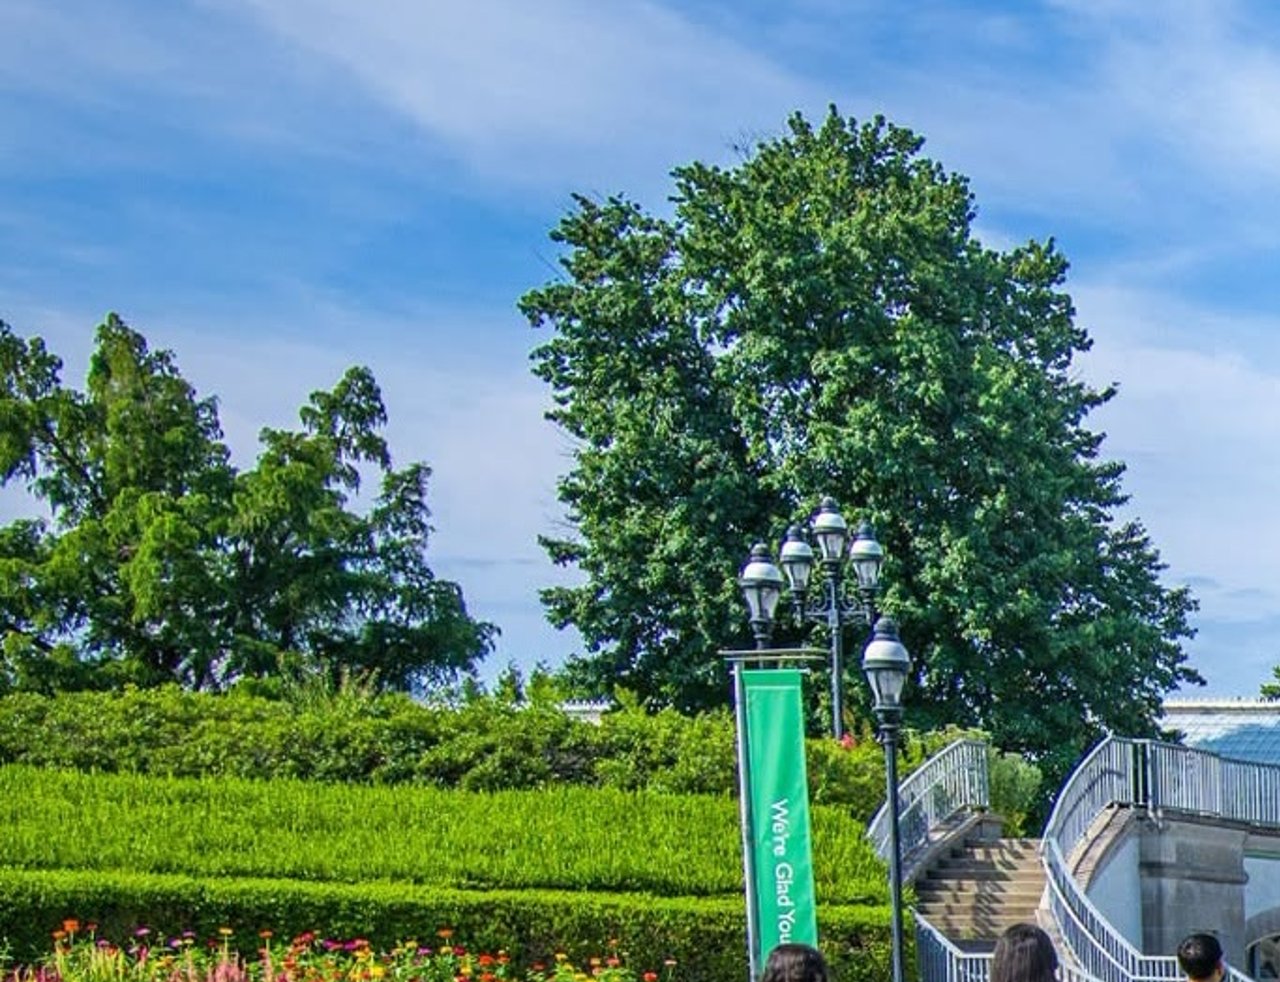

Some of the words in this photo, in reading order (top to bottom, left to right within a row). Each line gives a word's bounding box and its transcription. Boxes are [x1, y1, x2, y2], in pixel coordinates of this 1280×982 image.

[771, 798, 790, 857] We're
[775, 862, 795, 907] Glad
[777, 908, 796, 944] You
